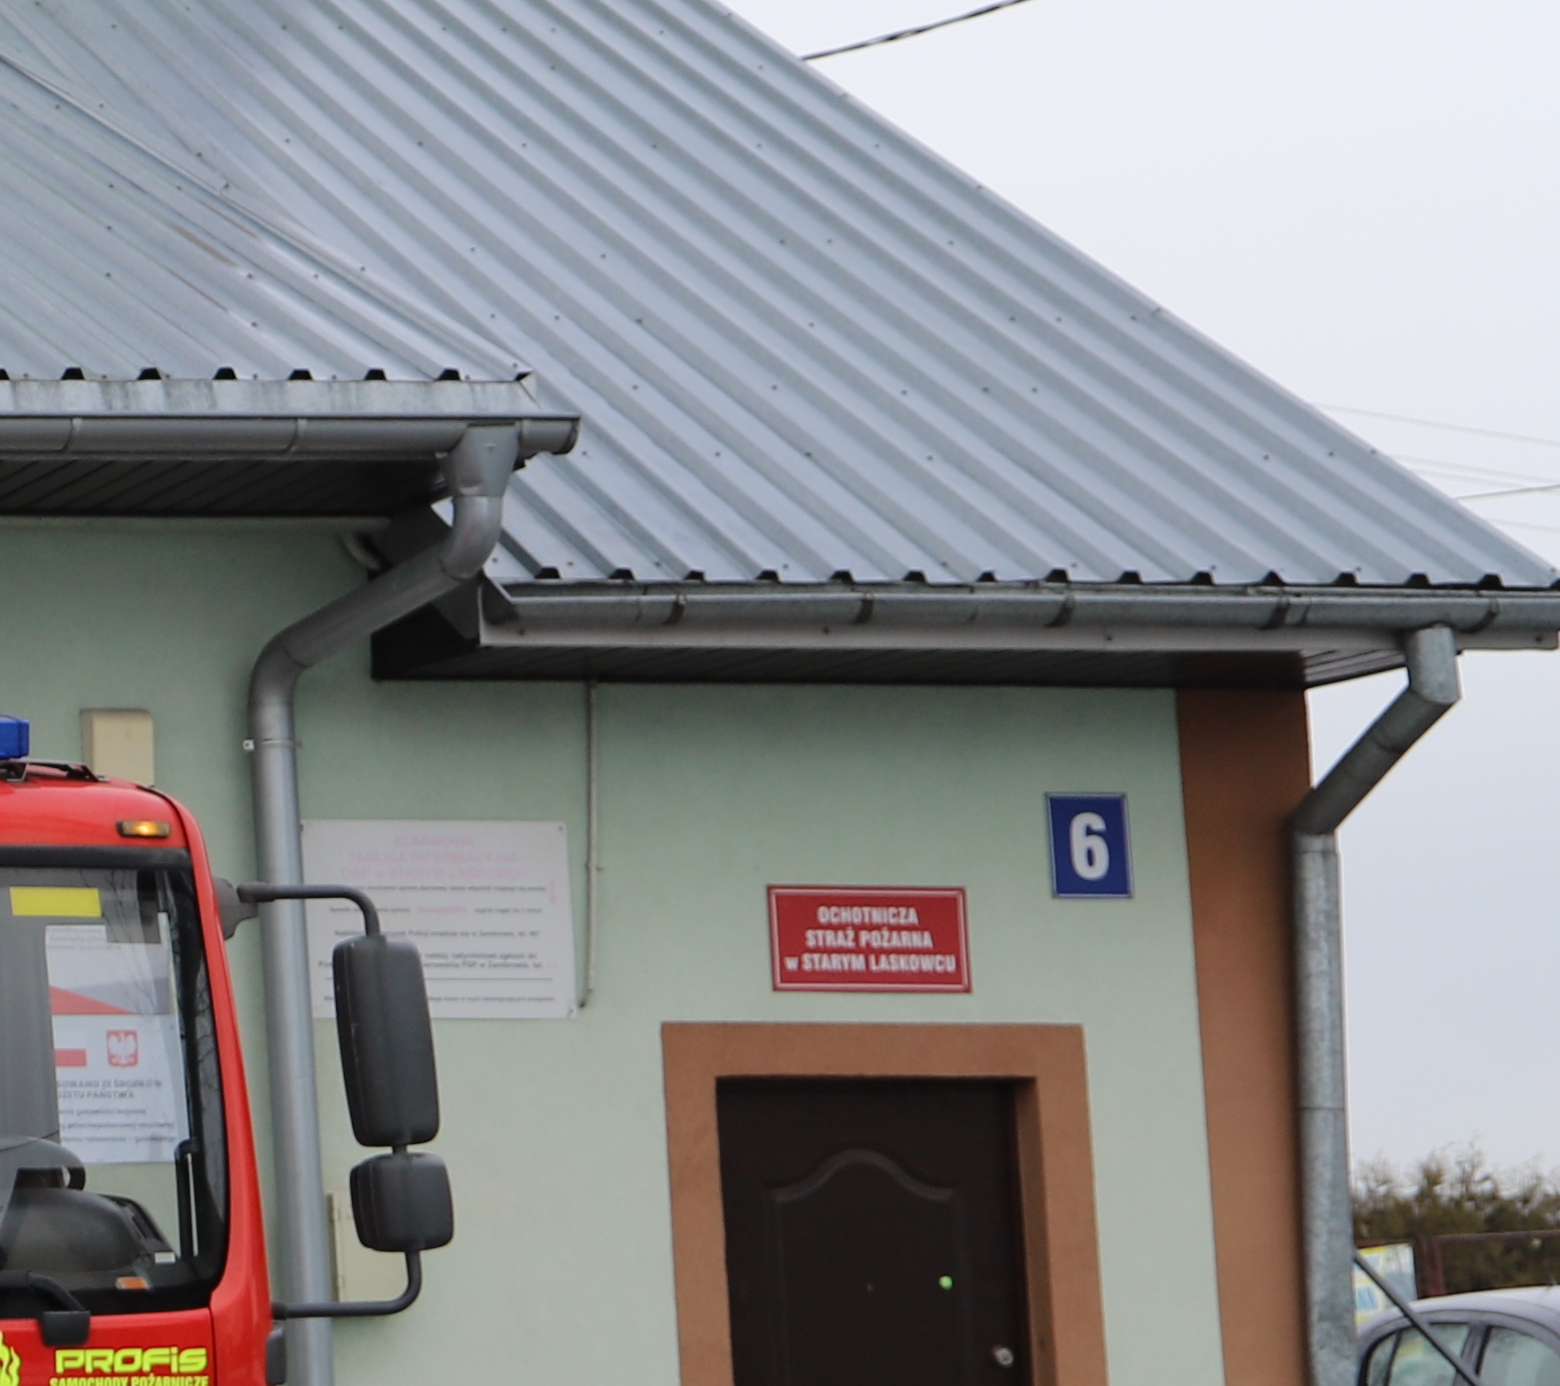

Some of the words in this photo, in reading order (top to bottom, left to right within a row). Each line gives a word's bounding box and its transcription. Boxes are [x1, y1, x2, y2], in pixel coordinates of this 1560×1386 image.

[1069, 811, 1110, 881] 6
[817, 906, 919, 925] OCHOTNICZA
[805, 926, 856, 948] STRAŻ
[859, 926, 934, 949] POŻARNA
[801, 952, 867, 972] STARYM
[870, 954, 957, 973] LASKOWCU
